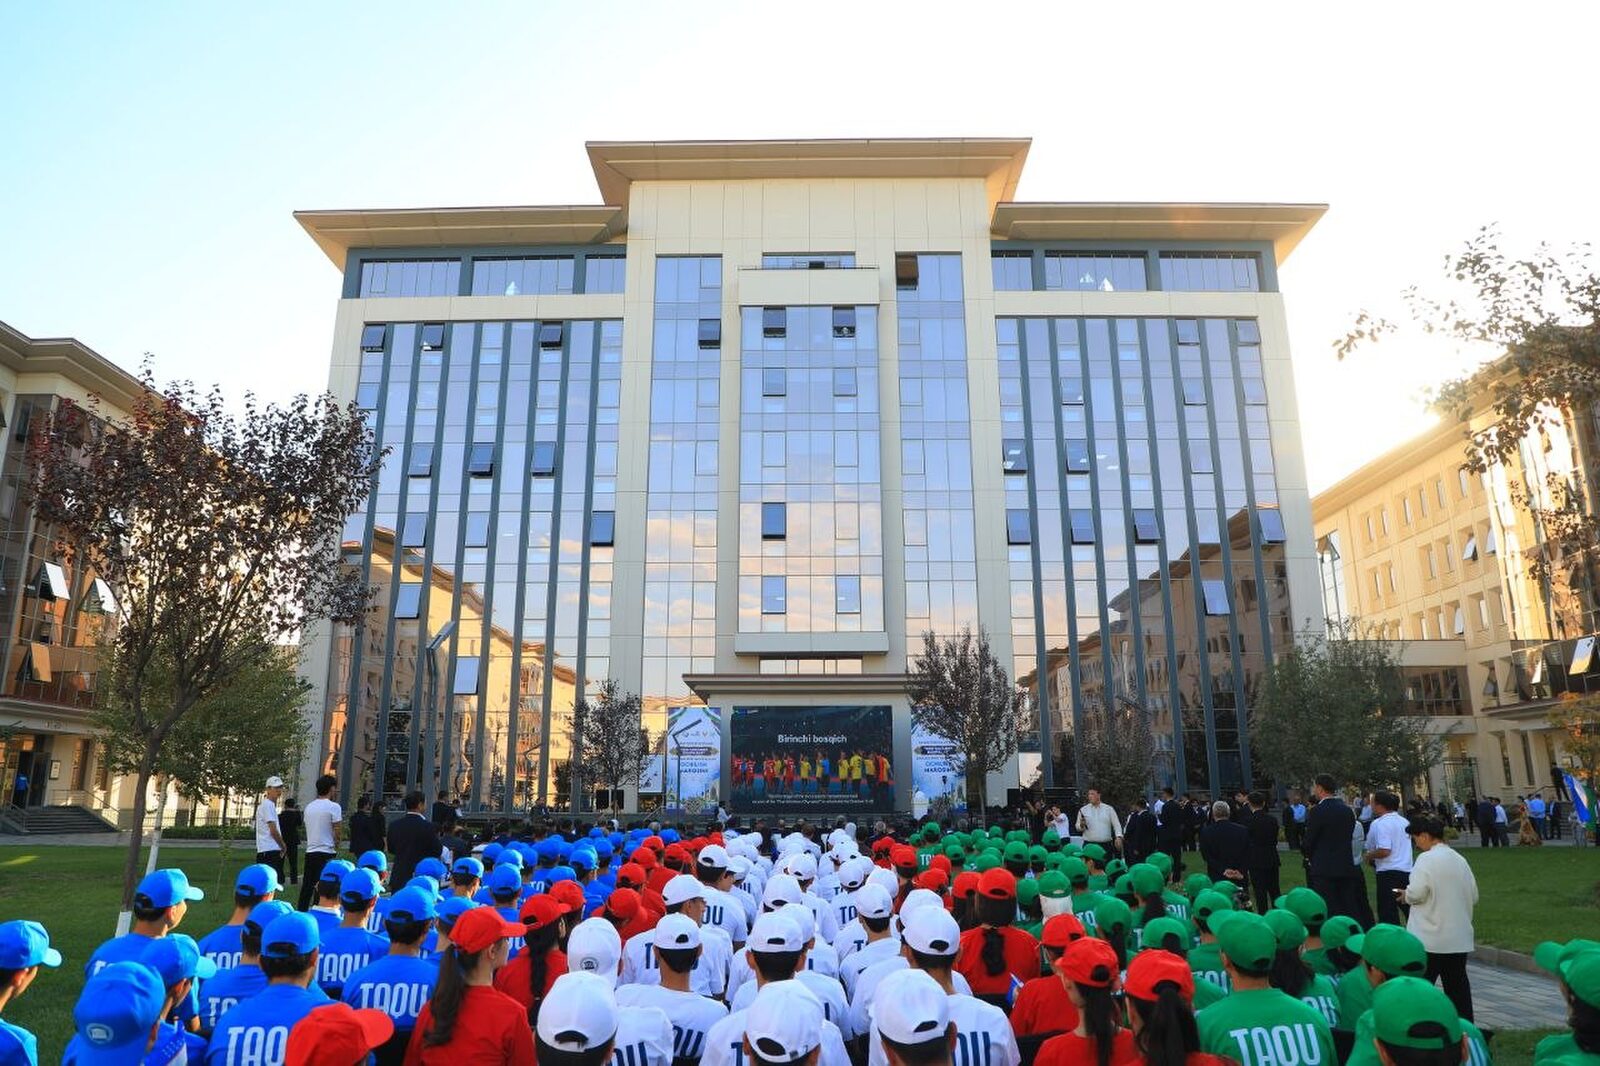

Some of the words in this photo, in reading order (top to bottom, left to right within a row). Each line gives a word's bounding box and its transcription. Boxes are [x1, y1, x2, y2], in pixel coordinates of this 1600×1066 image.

[777, 734, 811, 743] Birinchi
[812, 734, 848, 744] bosqich
[702, 905, 724, 926] QU
[360, 982, 430, 1019] TAQU
[225, 1025, 289, 1066] TAQ
[1229, 1023, 1321, 1066] TAQU
